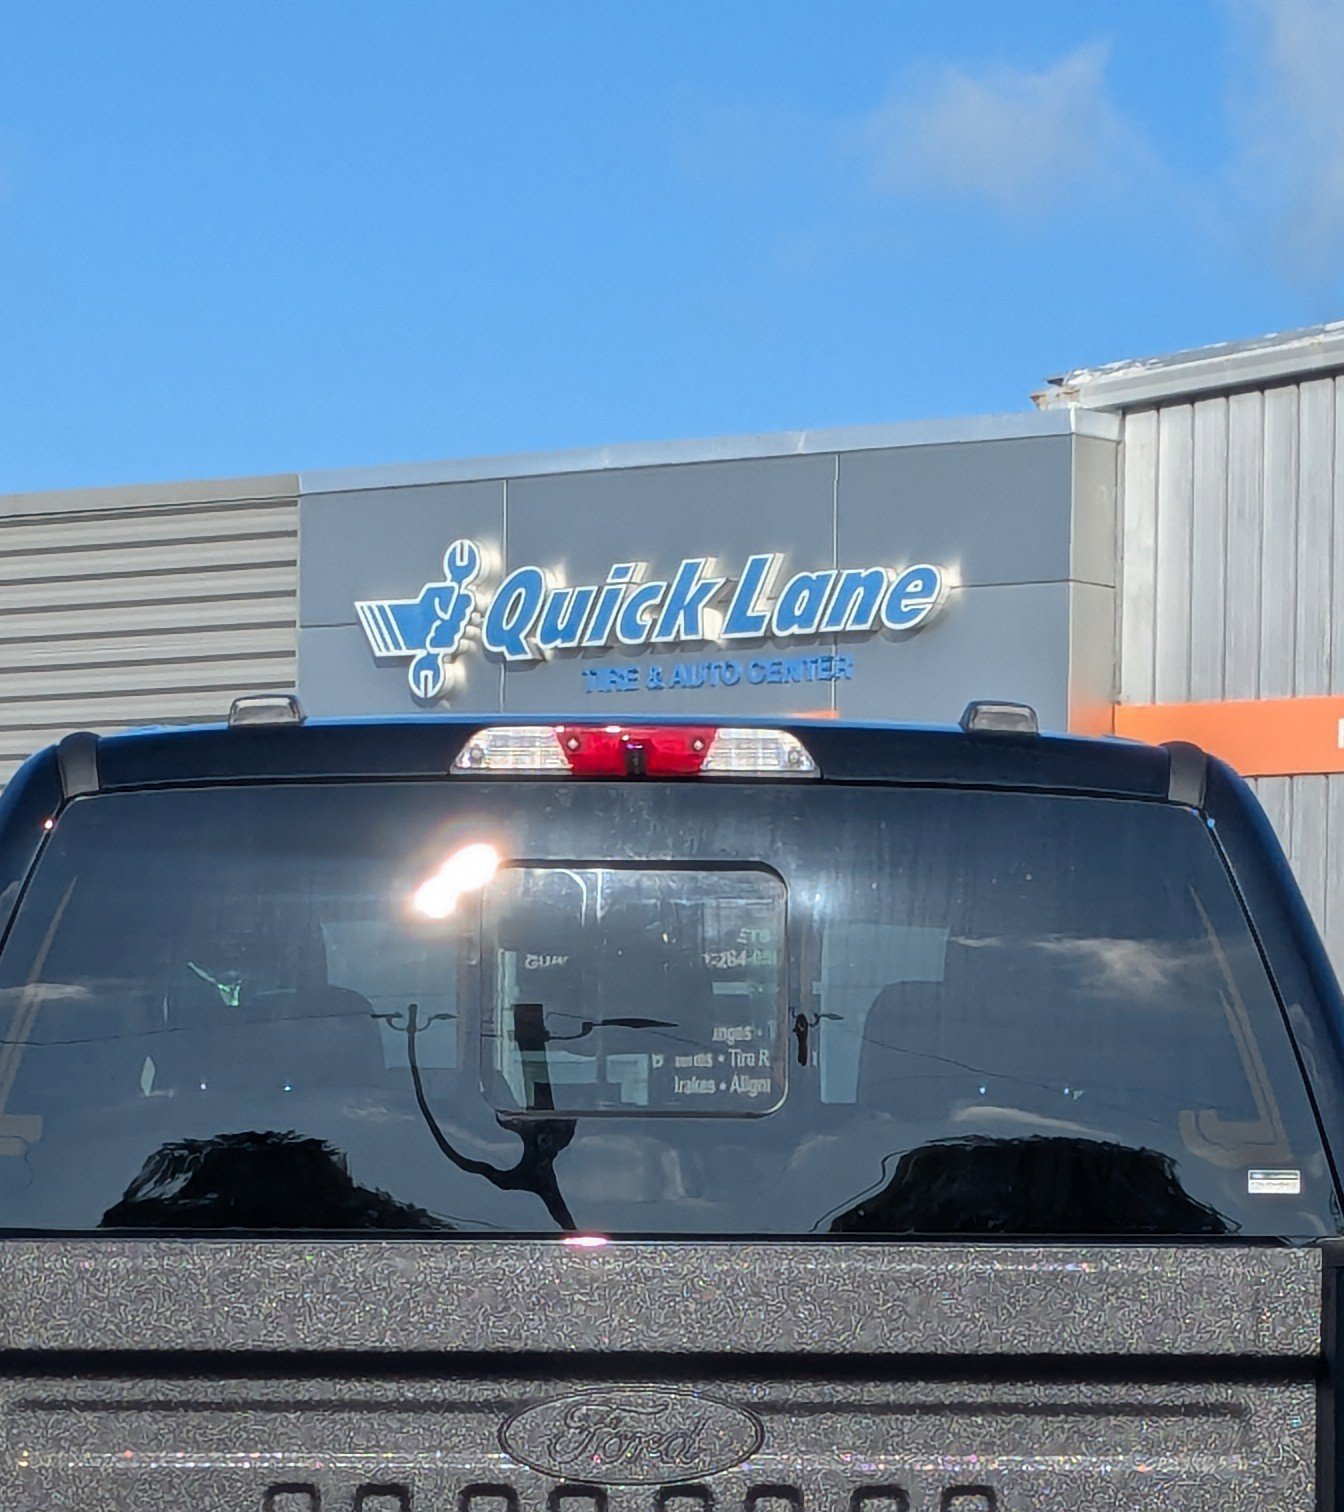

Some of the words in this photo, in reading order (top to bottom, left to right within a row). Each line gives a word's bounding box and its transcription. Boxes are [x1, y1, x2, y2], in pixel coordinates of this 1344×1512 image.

[482, 557, 726, 661] Quick
[720, 553, 943, 638] Lane
[582, 668, 640, 693] TIRE
[646, 667, 665, 690] &
[668, 659, 742, 689] AUTO
[748, 655, 854, 685] CENTER
[546, 1400, 712, 1470] Ford
